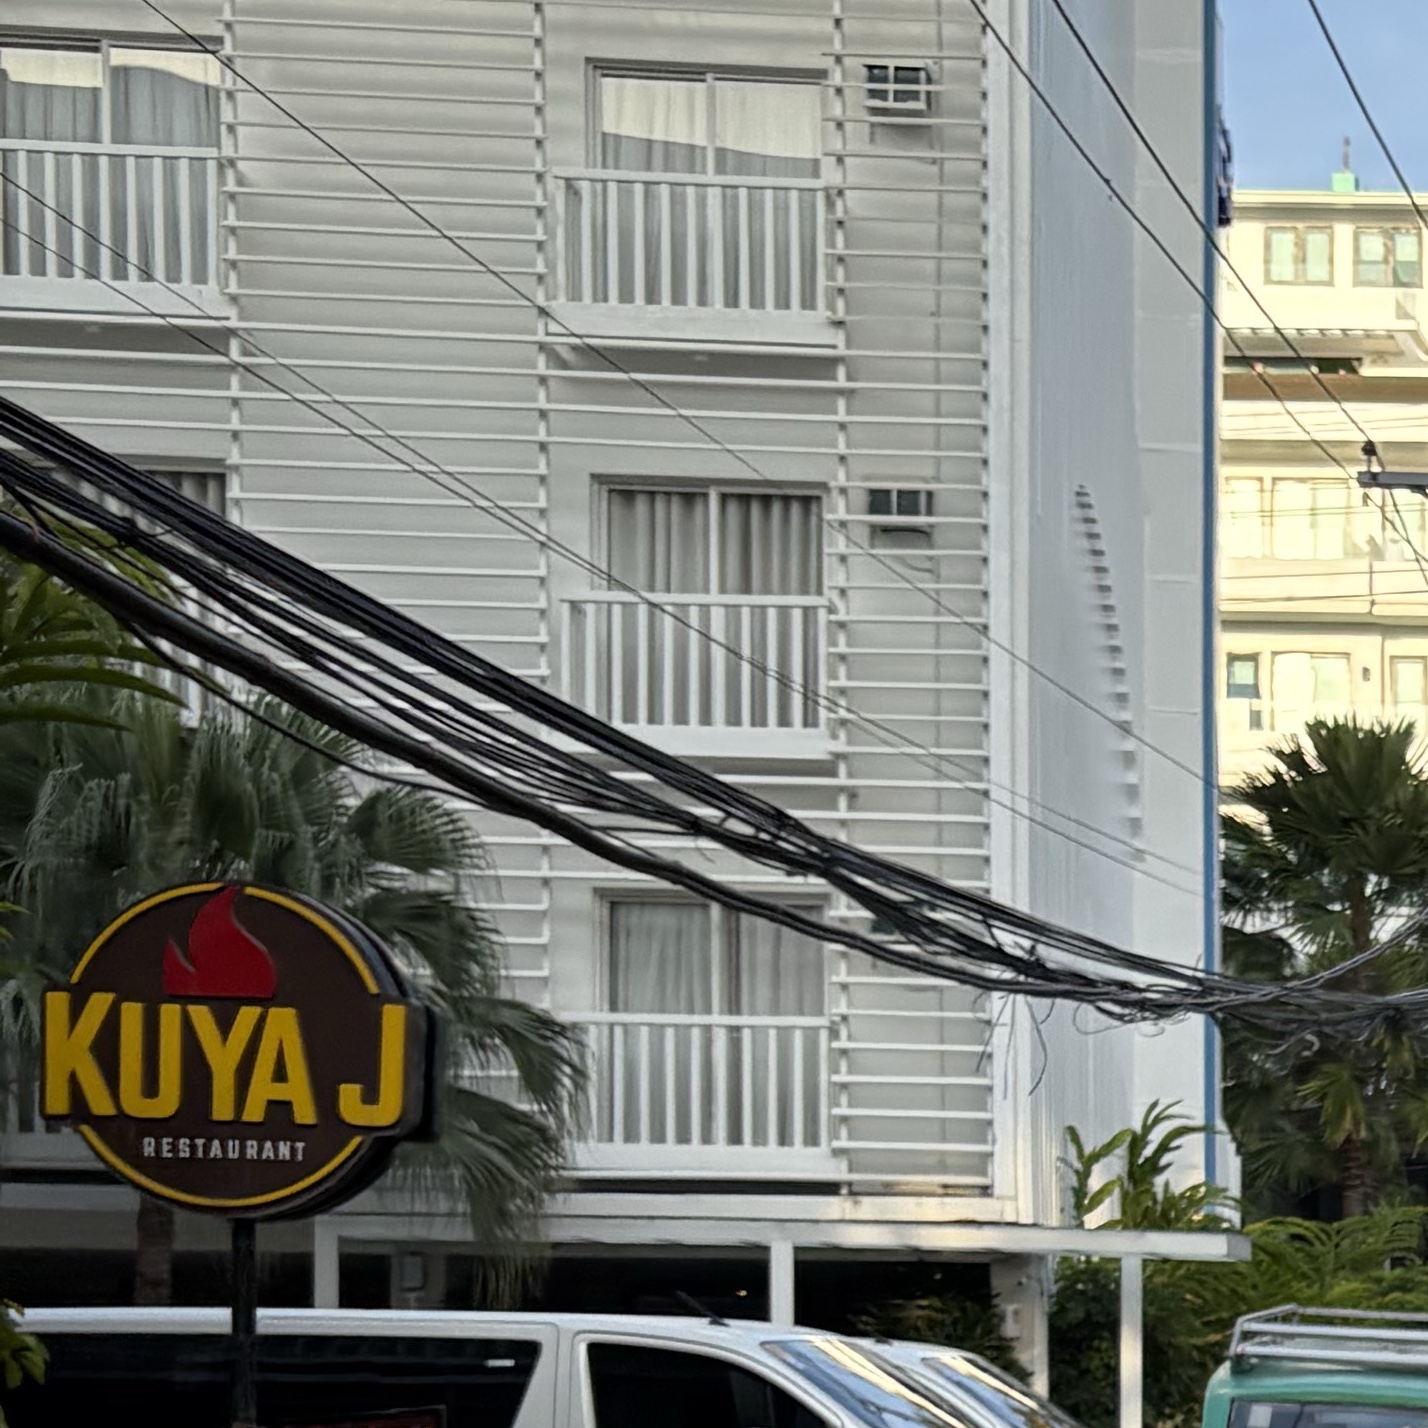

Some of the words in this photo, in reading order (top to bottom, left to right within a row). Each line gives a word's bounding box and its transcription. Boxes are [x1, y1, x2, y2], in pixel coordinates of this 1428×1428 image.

[44, 991, 318, 1125] KUYA
[337, 1004, 407, 1128] J
[142, 1136, 306, 1162] RESTAURANT
